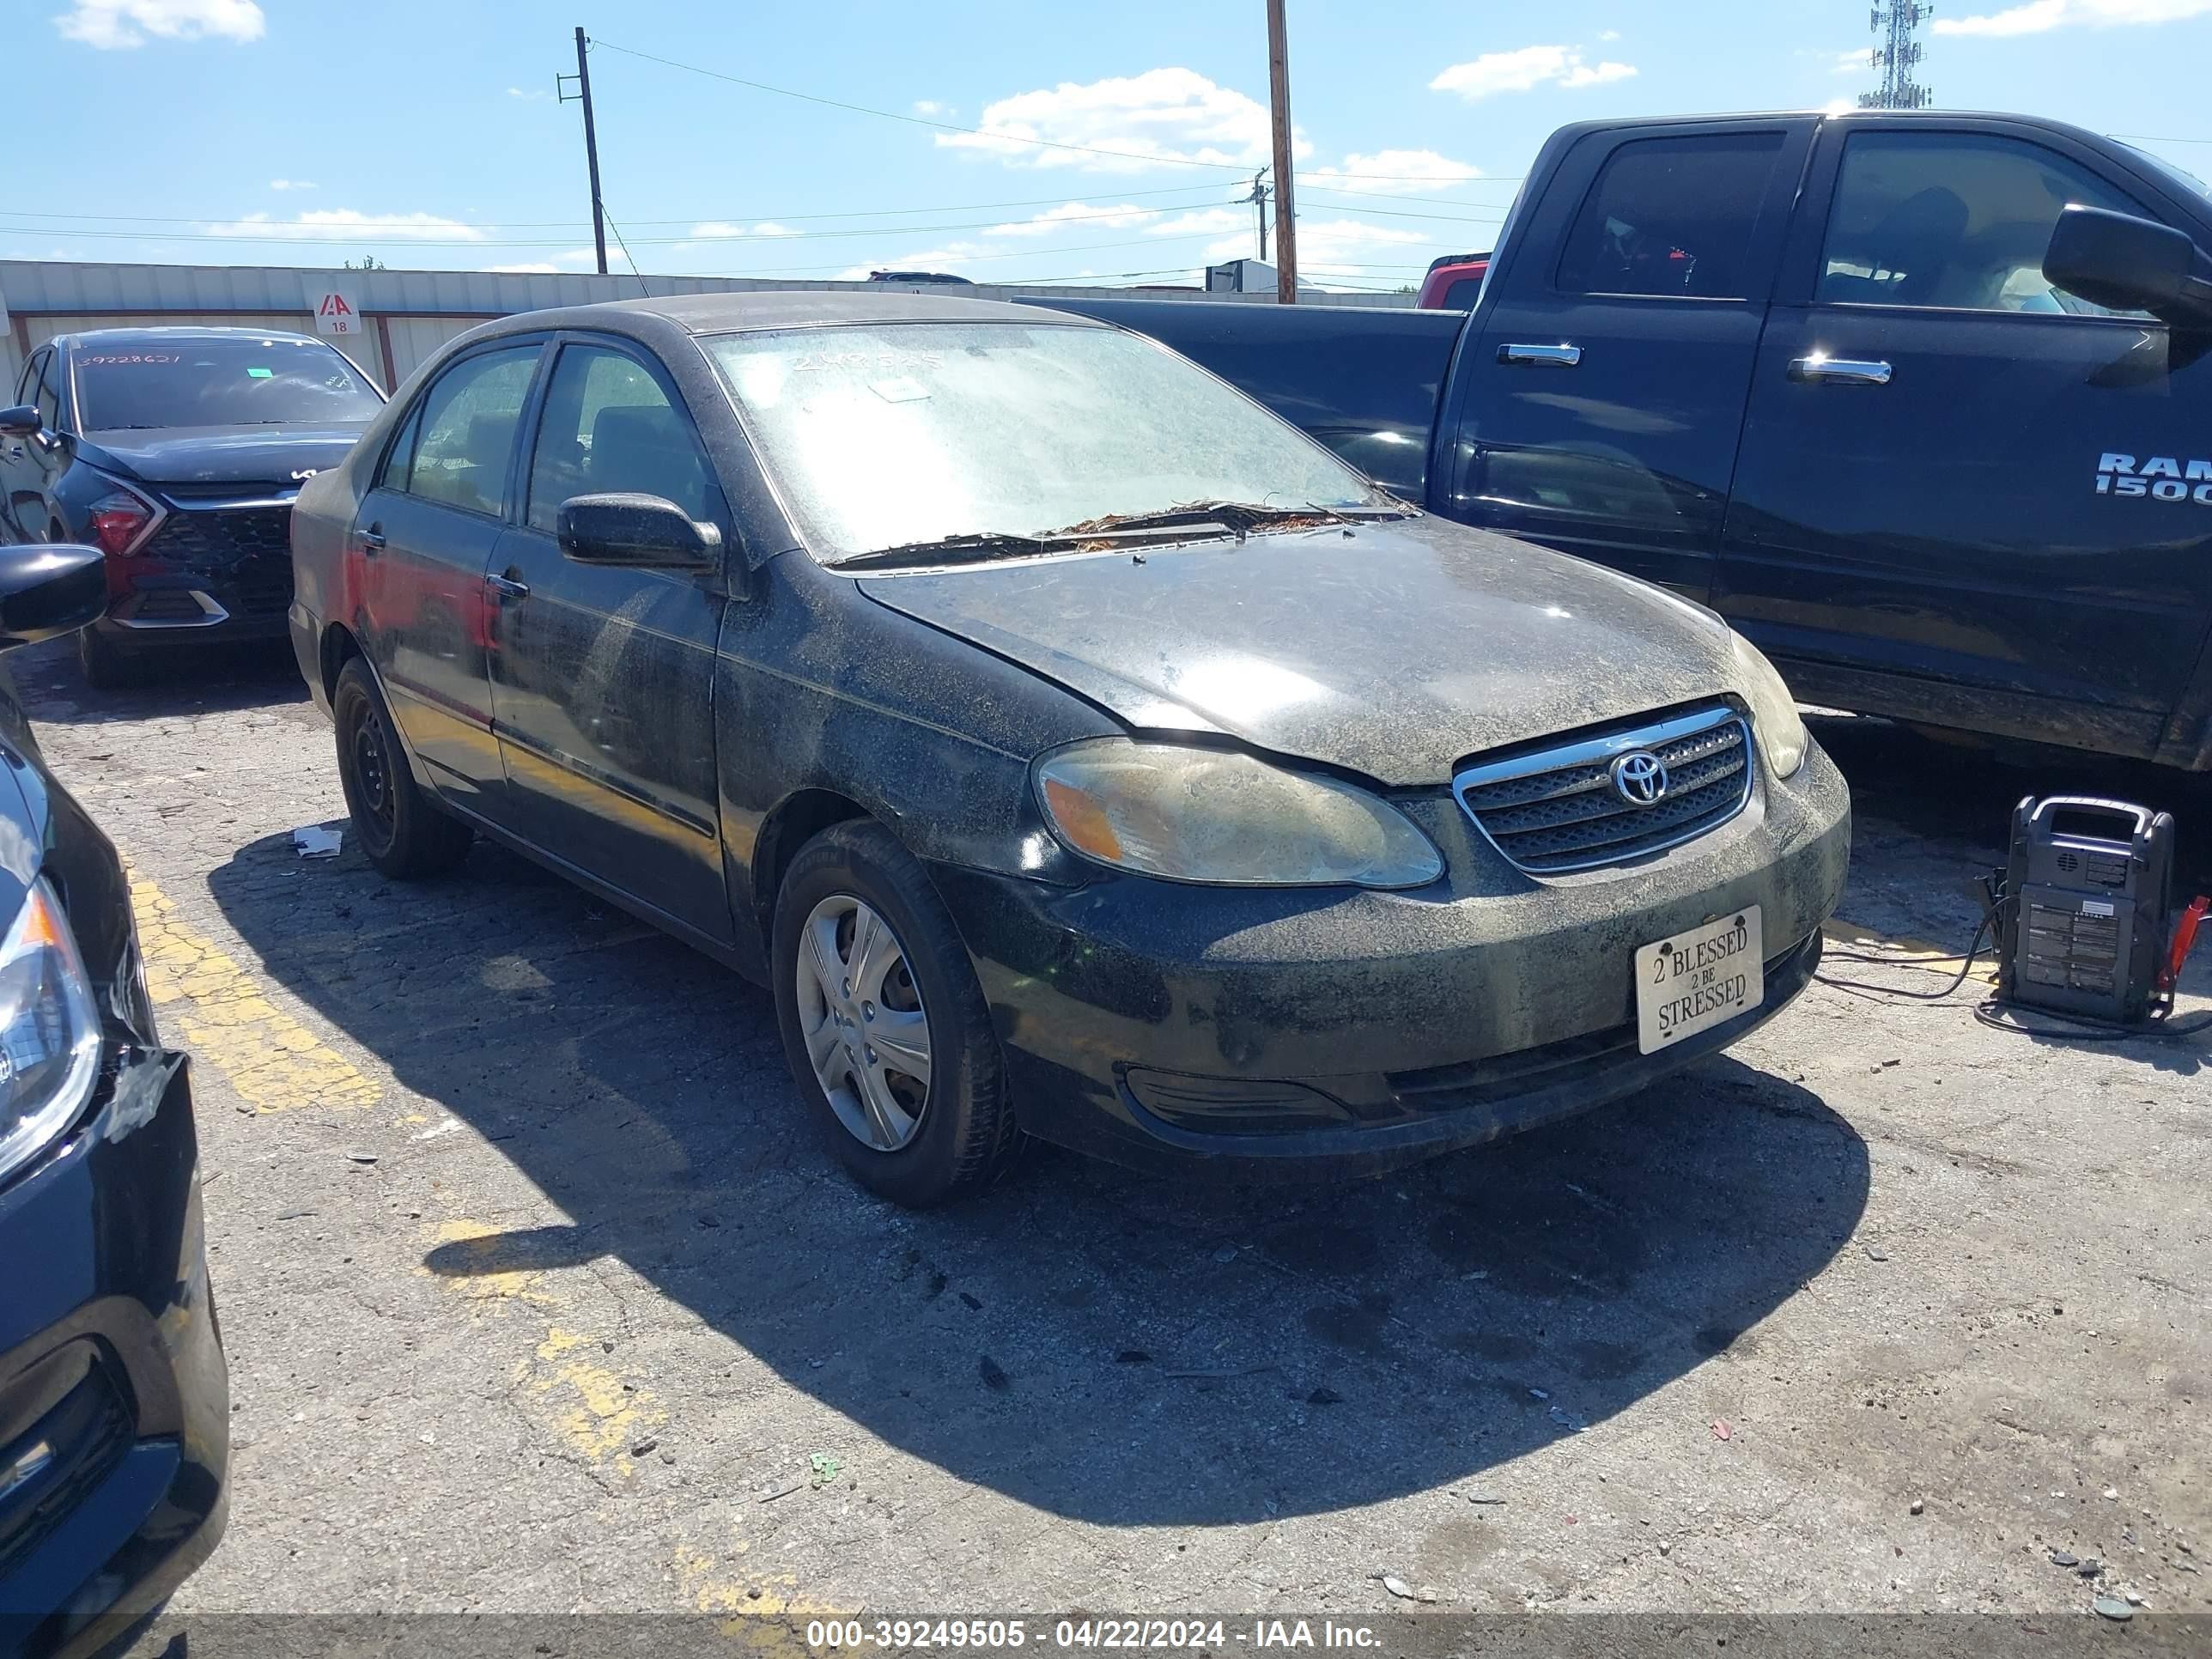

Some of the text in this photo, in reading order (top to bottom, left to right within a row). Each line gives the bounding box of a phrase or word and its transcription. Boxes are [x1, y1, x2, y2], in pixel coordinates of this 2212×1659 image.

[332, 322, 347, 332] 18
[77, 355, 179, 367] 39228621
[2096, 475, 2212, 505] 1500
[1653, 927, 1748, 984] 2 BLESSED
[1692, 967, 1716, 989] 2 BE
[1658, 974, 1747, 1031] STRESSED
